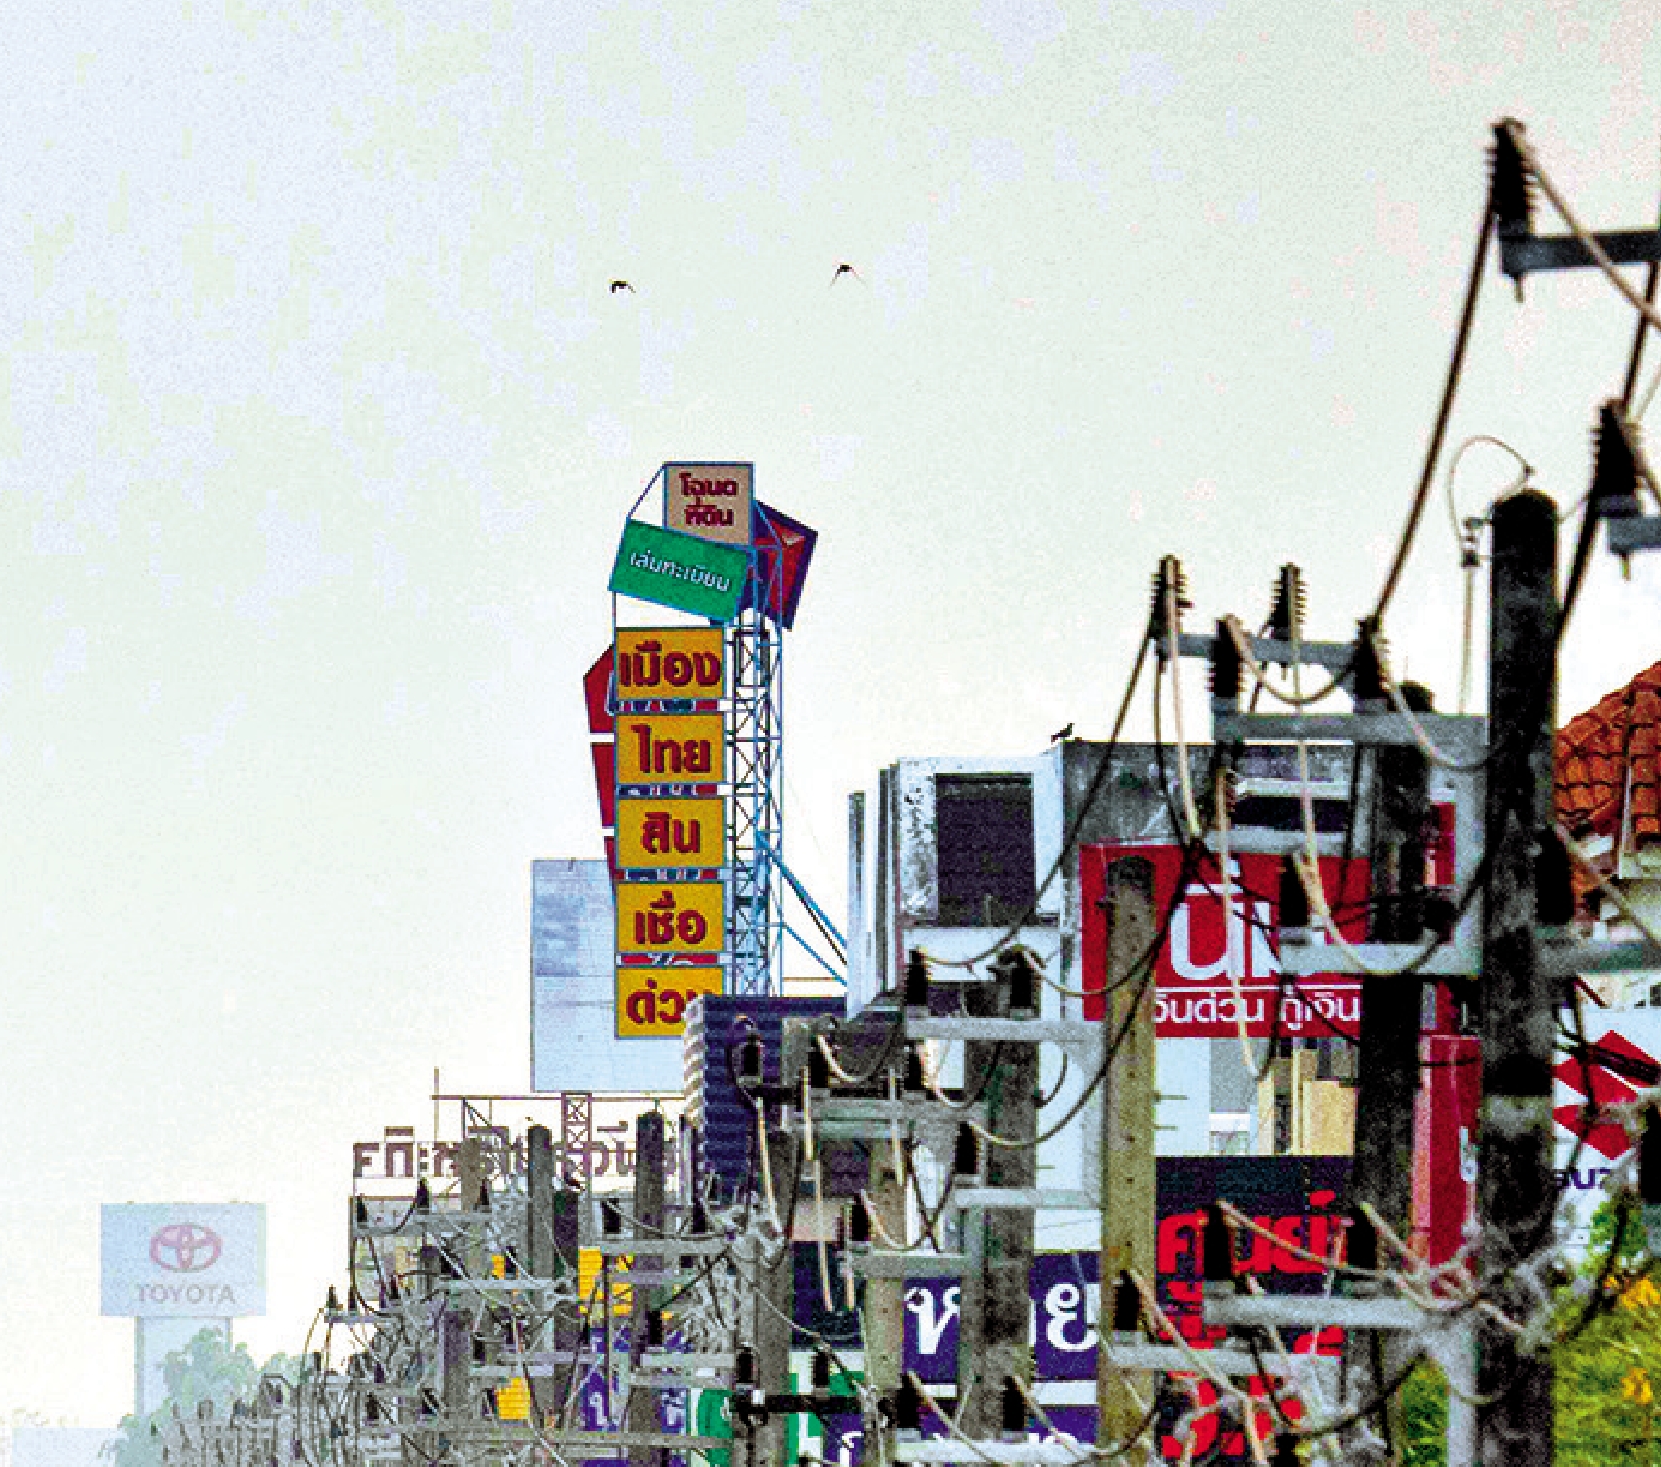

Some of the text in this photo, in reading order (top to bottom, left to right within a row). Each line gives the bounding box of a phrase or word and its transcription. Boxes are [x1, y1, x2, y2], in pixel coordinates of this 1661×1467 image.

[618, 640, 720, 688] เมือง
[631, 725, 712, 775] ไทย
[642, 811, 700, 854] สิน
[633, 891, 706, 946] เชื่อ
[626, 979, 712, 1027] ด่ว
[138, 1283, 236, 1305] TOYOTA
